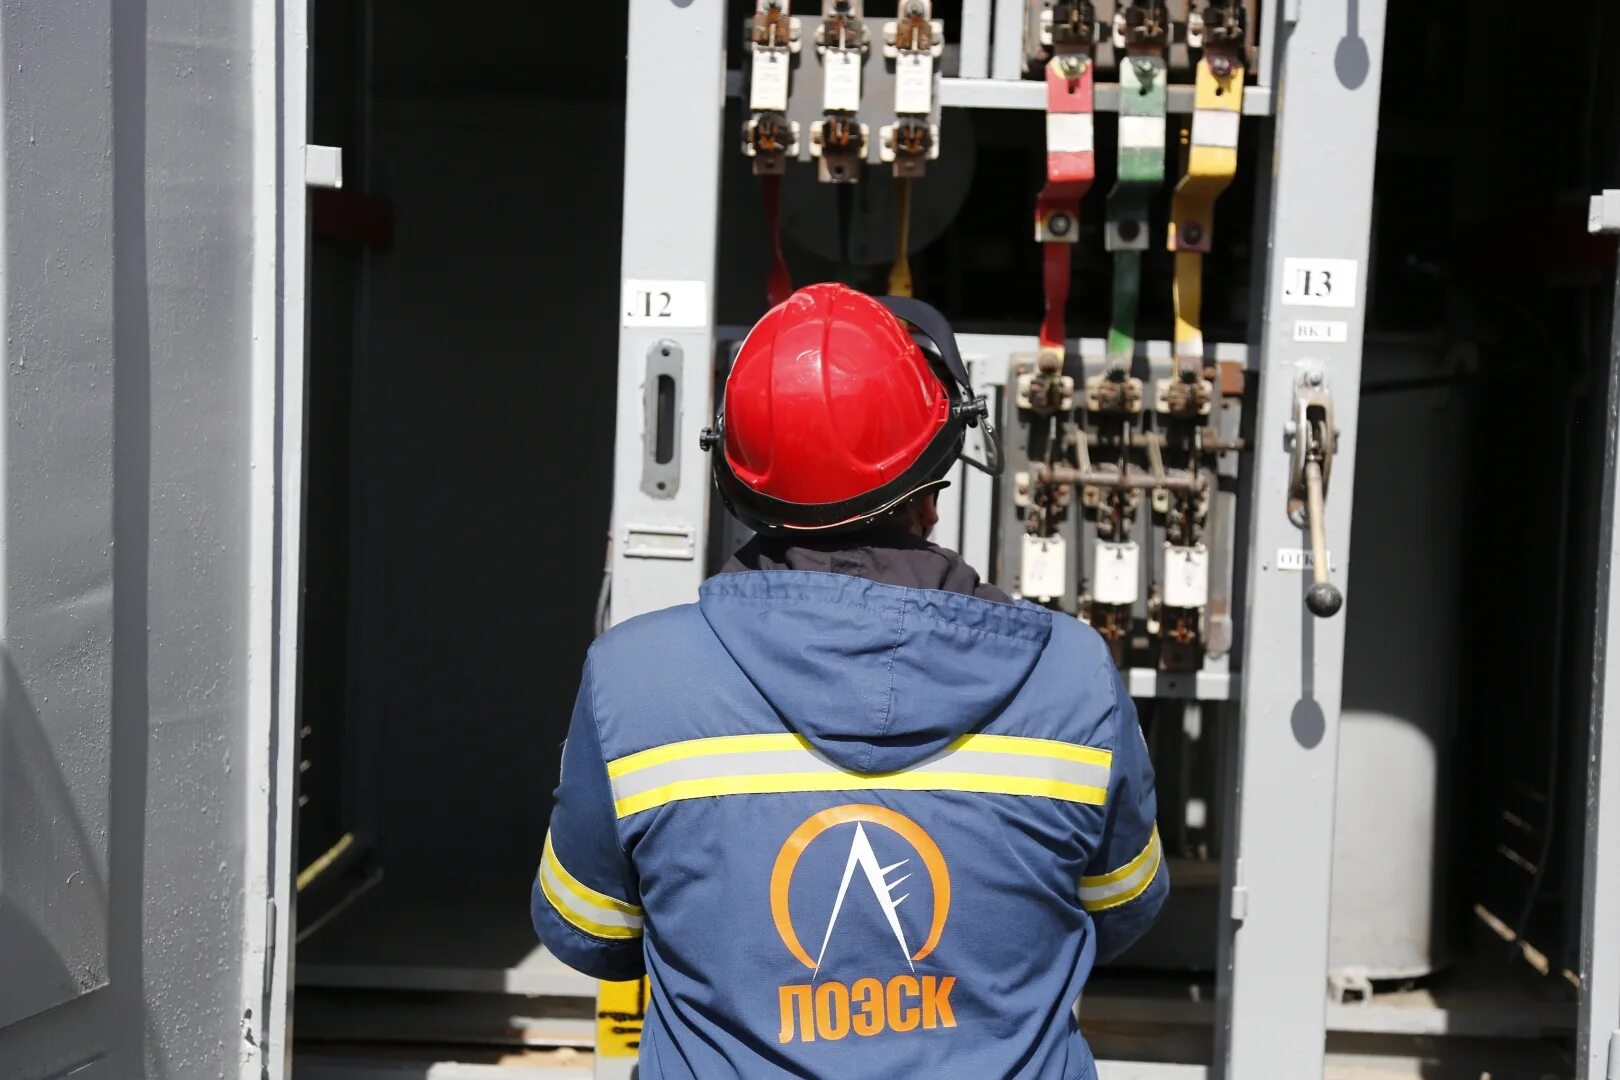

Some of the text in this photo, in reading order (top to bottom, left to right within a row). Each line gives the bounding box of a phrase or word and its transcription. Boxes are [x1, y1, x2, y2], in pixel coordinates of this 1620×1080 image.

[1285, 269, 1331, 297] Л3
[626, 290, 672, 318] Л2
[778, 974, 958, 1044] ЛОЭСК
